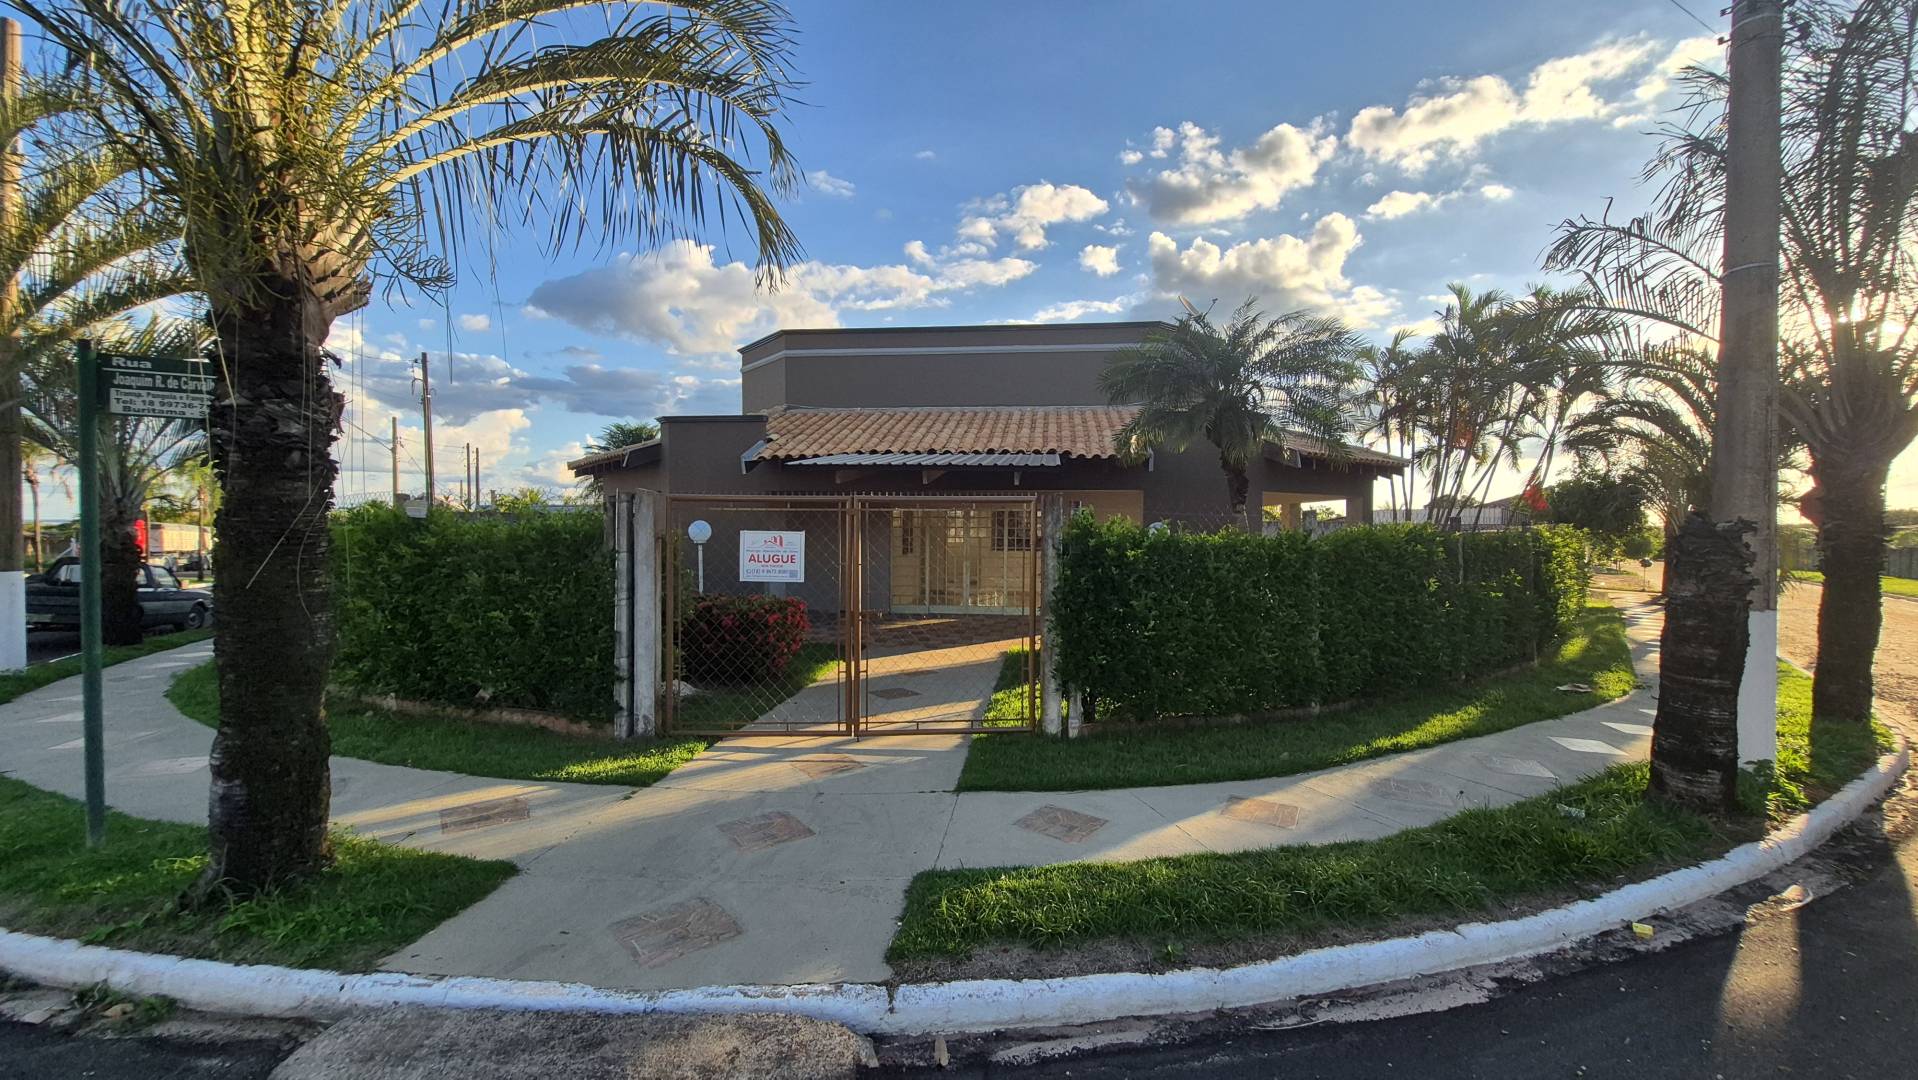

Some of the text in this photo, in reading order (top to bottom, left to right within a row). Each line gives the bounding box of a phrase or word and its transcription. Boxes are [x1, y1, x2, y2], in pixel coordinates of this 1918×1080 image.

[112, 356, 152, 369] Rua
[113, 372, 153, 389] Joaquim
[167, 376, 179, 389] de
[180, 377, 215, 391] Carvalh
[113, 397, 136, 405] Tel:
[141, 399, 155, 408] 18
[122, 405, 187, 416] Buritama
[748, 554, 796, 564] ALUGUE
